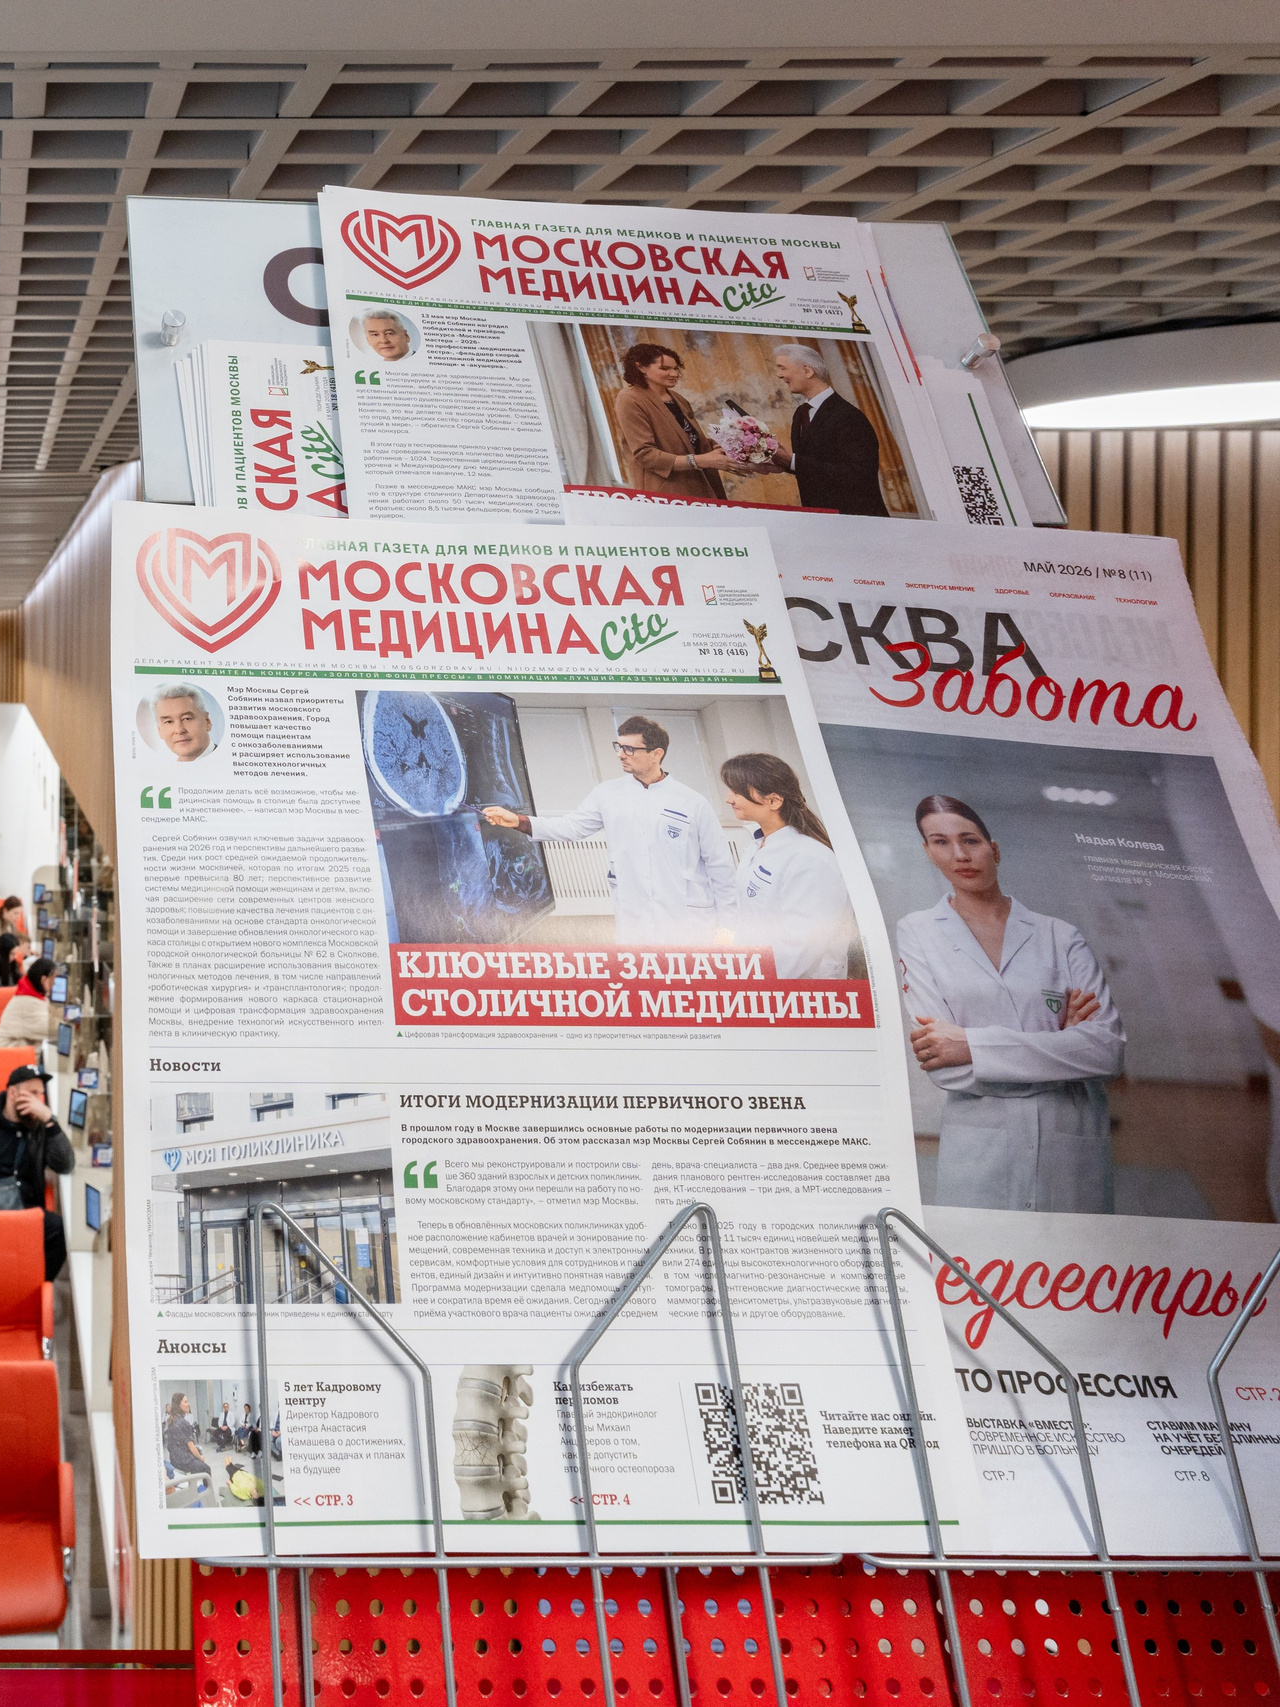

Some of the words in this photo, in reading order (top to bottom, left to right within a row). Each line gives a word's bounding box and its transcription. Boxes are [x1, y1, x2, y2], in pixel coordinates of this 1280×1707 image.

[470, 218, 531, 230] ГЛАВНАЯ
[534, 223, 582, 234] ГАЗЕТА
[585, 227, 613, 236] ДЛЯ
[616, 228, 682, 241] МЕДИКОВ
[685, 233, 695, 241] И
[698, 233, 778, 246] ПАЦИЕНТОВ
[781, 238, 841, 249] МОСКВЫ
[473, 231, 790, 280] МОСКОВСКАЯ
[479, 264, 723, 308] МЕДИЦИНА
[722, 281, 786, 312] Cito
[228, 355, 241, 406] МОСКВЫ
[231, 410, 246, 481] ПАЦИЕНТОВ
[300, 420, 345, 480] Cito
[237, 485, 246, 493] И
[297, 538, 369, 552] ЛВНАЯ
[373, 541, 431, 555] ГАЗЕТА
[435, 544, 468, 557] ДЛЯ
[473, 544, 554, 557] МЕДИКОВ
[558, 545, 570, 556] И
[574, 545, 671, 558] ПАЦИЕНТОВ
[675, 546, 750, 558] МОСКВЫ
[1023, 561, 1056, 574] МАЙ
[1057, 564, 1093, 577] 2026
[1102, 568, 1117, 578] №
[1118, 569, 1127, 579] 8
[1128, 569, 1153, 583] (11)
[298, 559, 685, 606] МОСКОВСКАЯ
[801, 575, 834, 583] ИСТОРИИ
[905, 582, 948, 591] ЭКСПЕРТНОЕ
[947, 585, 976, 593] МНЕНИЕ
[995, 588, 1030, 596] ЗДОРОВЬЕ
[1049, 592, 1096, 601] ОБРАЗОВАНИЕ
[1114, 597, 1159, 607] ТЕХНОЛОГИИ
[301, 608, 600, 660] МЕДИЦИНА
[600, 612, 679, 661] Cito
[698, 648, 711, 656] №
[712, 648, 724, 656] 18
[726, 647, 749, 657] (416)
[227, 687, 244, 695] Мэр
[246, 686, 278, 694] Москвы
[280, 687, 310, 696] Сергей
[869, 641, 1198, 732] Забота
[227, 695, 263, 703] Собянин
[229, 714, 305, 722] здравоохранения.
[306, 715, 331, 723] Город
[230, 732, 264, 740] помощи
[265, 733, 312, 741] пациентам
[237, 741, 323, 750] онкозаболеваниями
[238, 751, 285, 760] расширяет
[286, 752, 351, 760] использование
[1075, 833, 1116, 846] Надья
[1117, 837, 1165, 851] Колева
[397, 951, 611, 981] КЛЮЧЕВЫЕ
[619, 952, 765, 985] ЗАДАЧИ
[401, 983, 634, 1018] СТОЛИЧНОЙ
[639, 991, 862, 1024] МЕДИЦИНЫ
[149, 1058, 221, 1072] Новости
[399, 1094, 462, 1108] ИТОГИ
[465, 1094, 619, 1112] МОДЕРНИЗАЦИИ
[622, 1095, 744, 1110] ПЕРВИЧНОГО
[747, 1096, 807, 1110] ЗВЕНА
[400, 1123, 408, 1132] В
[409, 1125, 453, 1134] прошлом
[454, 1125, 475, 1134] году
[484, 1124, 520, 1133] Москве
[522, 1125, 585, 1134] завершились
[634, 1124, 669, 1135] работы
[684, 1126, 752, 1135] модернизации
[754, 1127, 809, 1135] первичного
[185, 1148, 217, 1165] МОЯ
[219, 1130, 345, 1162] ПОЛИКЛИНИКА
[156, 1339, 227, 1354] Анонсы
[284, 1381, 291, 1392] 5
[293, 1384, 314, 1392] лет
[315, 1381, 382, 1394] Кадровому
[284, 1397, 327, 1408] центру
[819, 1410, 868, 1421] Читайте
[870, 1413, 890, 1421] нас
[892, 1411, 937, 1421] онлйн.
[822, 1424, 878, 1435] Наведите
[880, 1426, 914, 1437] камер
[1028, 1420, 1092, 1430] «ВМЕСТ»:
[826, 1438, 881, 1450] телефона
[884, 1441, 898, 1449] на
[900, 1438, 916, 1449] QR
[925, 1441, 940, 1449] од
[1055, 1433, 1126, 1443] ИСКССТВО
[983, 1470, 1008, 1481] СТР.
[1008, 1471, 1015, 1481] 7
[1175, 1471, 1200, 1481] СТР.
[1201, 1471, 1210, 1481] 8
[314, 1494, 344, 1507] СТР.
[347, 1494, 354, 1506] 3
[591, 1493, 620, 1505] СТР.
[623, 1493, 631, 1505] 4
